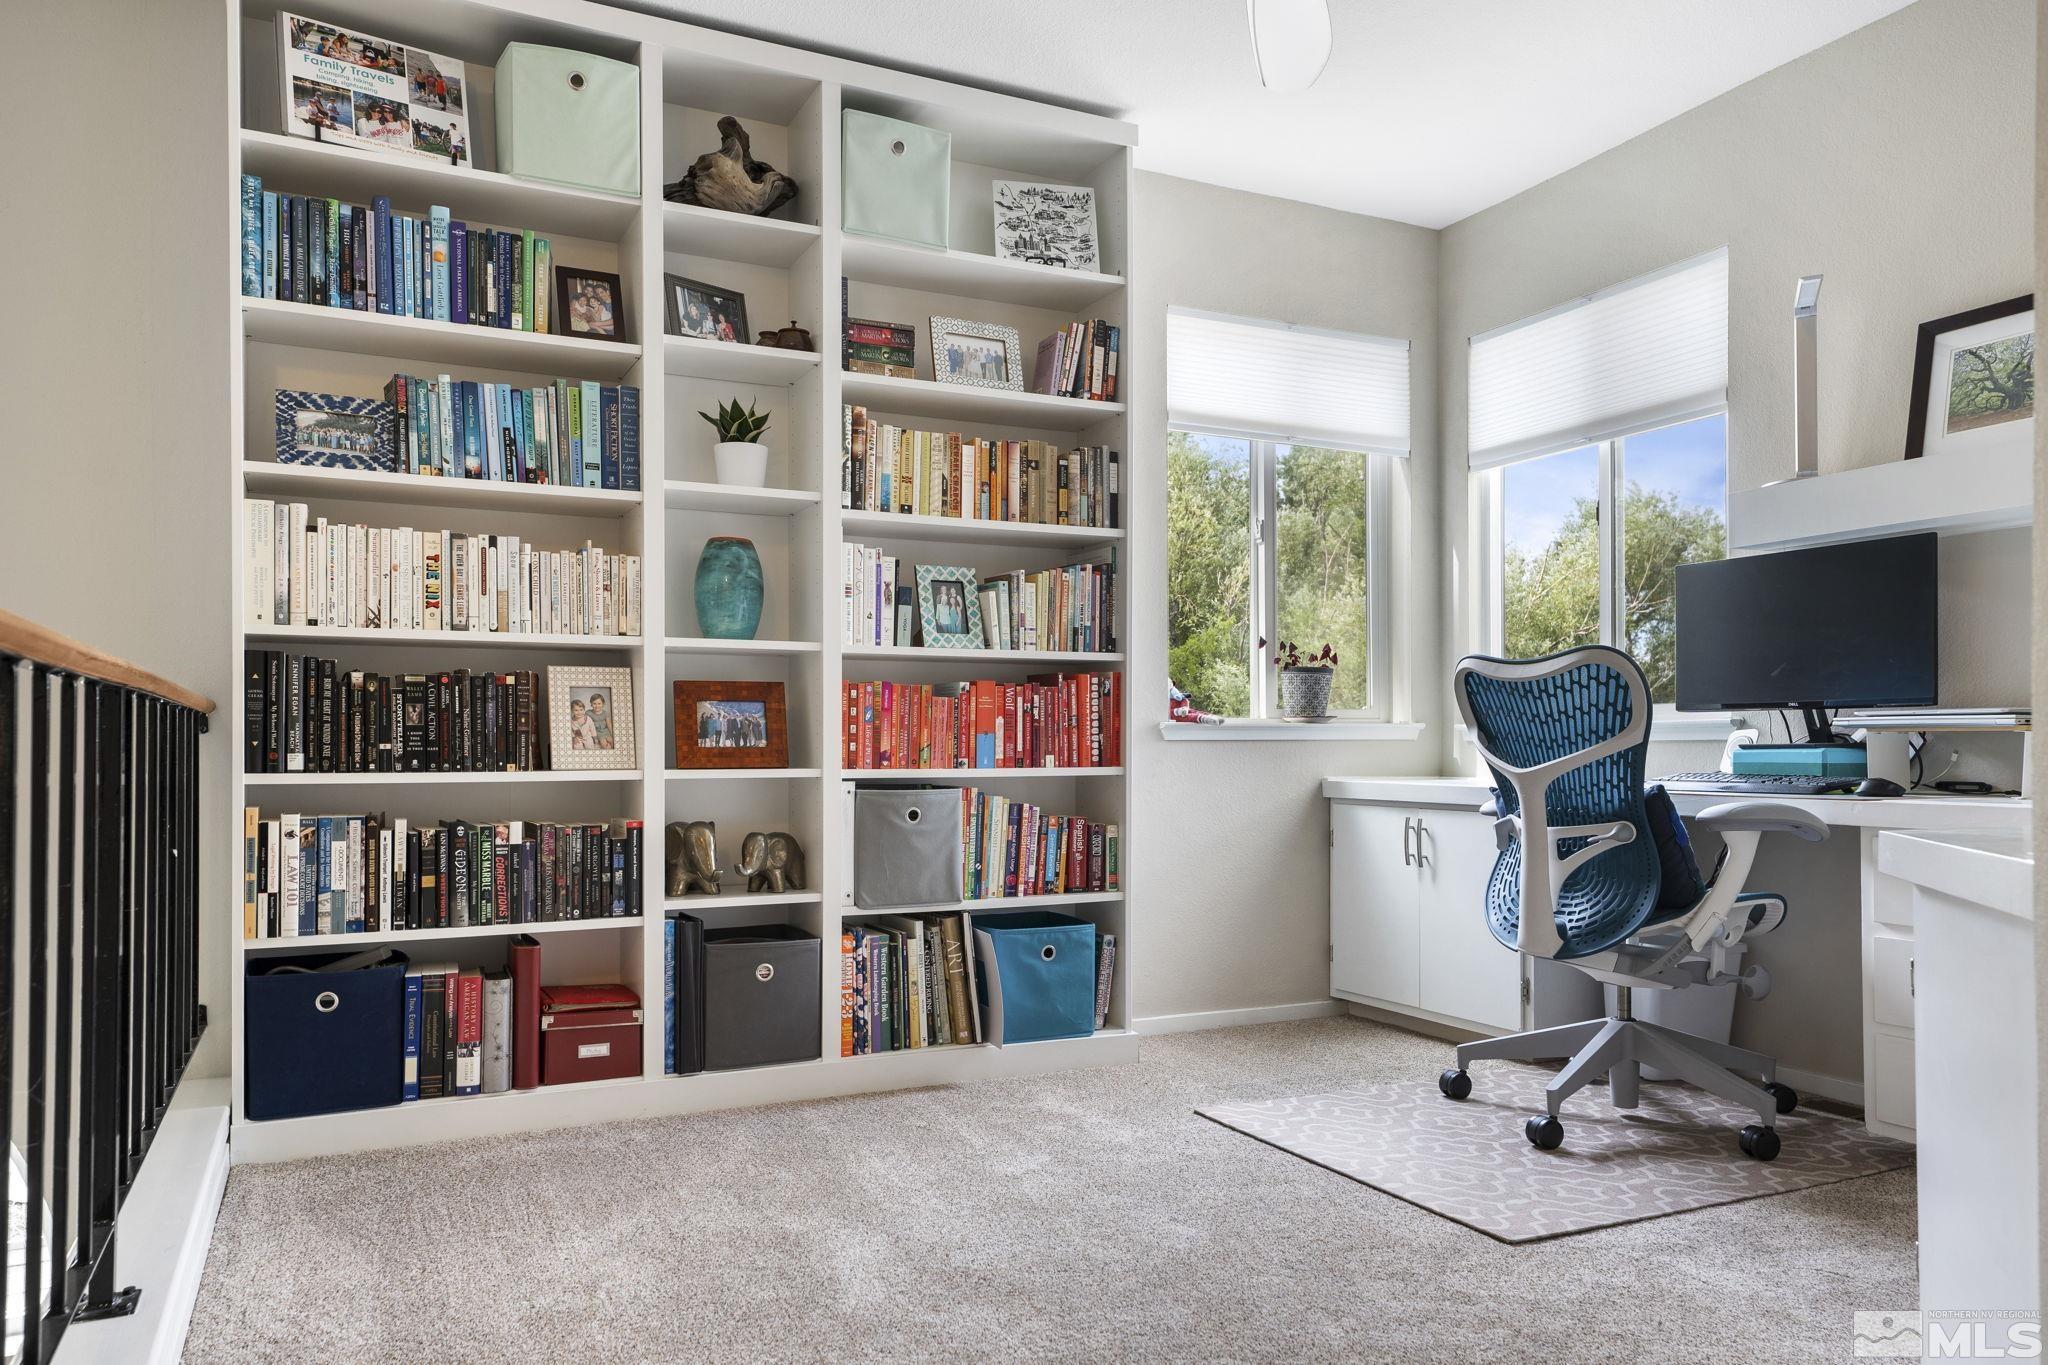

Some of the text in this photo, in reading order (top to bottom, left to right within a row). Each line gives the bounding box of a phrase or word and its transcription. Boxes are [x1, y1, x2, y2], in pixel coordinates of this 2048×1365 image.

[304, 54, 395, 85] Family Travels
[282, 268, 290, 280] TIME
[397, 378, 407, 414] BLOWBACK
[590, 400, 598, 448] LITERATURE
[609, 403, 618, 462] SHORT FICTION
[426, 554, 441, 580] THE
[456, 568, 464, 577] DAY
[855, 567, 863, 596] YOGA
[427, 688, 436, 708] CIVIL
[1005, 687, 1015, 711] Wolf
[427, 711, 436, 740] ACTION
[462, 708, 470, 756] Nadine Gordimer
[865, 738, 872, 746] of
[865, 747, 872, 755] Pi
[1075, 819, 1085, 852] Spanish
[481, 841, 492, 891] MISS MARBLE
[287, 855, 298, 908] LAW 101
[495, 857, 508, 917] CORRECTIONS
[545, 887, 553, 914] GENERALS
[845, 953, 853, 987] HOME
[880, 947, 888, 975] Western
[946, 939, 964, 976] ART
[880, 976, 889, 1002] Garden
[470, 1026, 477, 1036] OF
